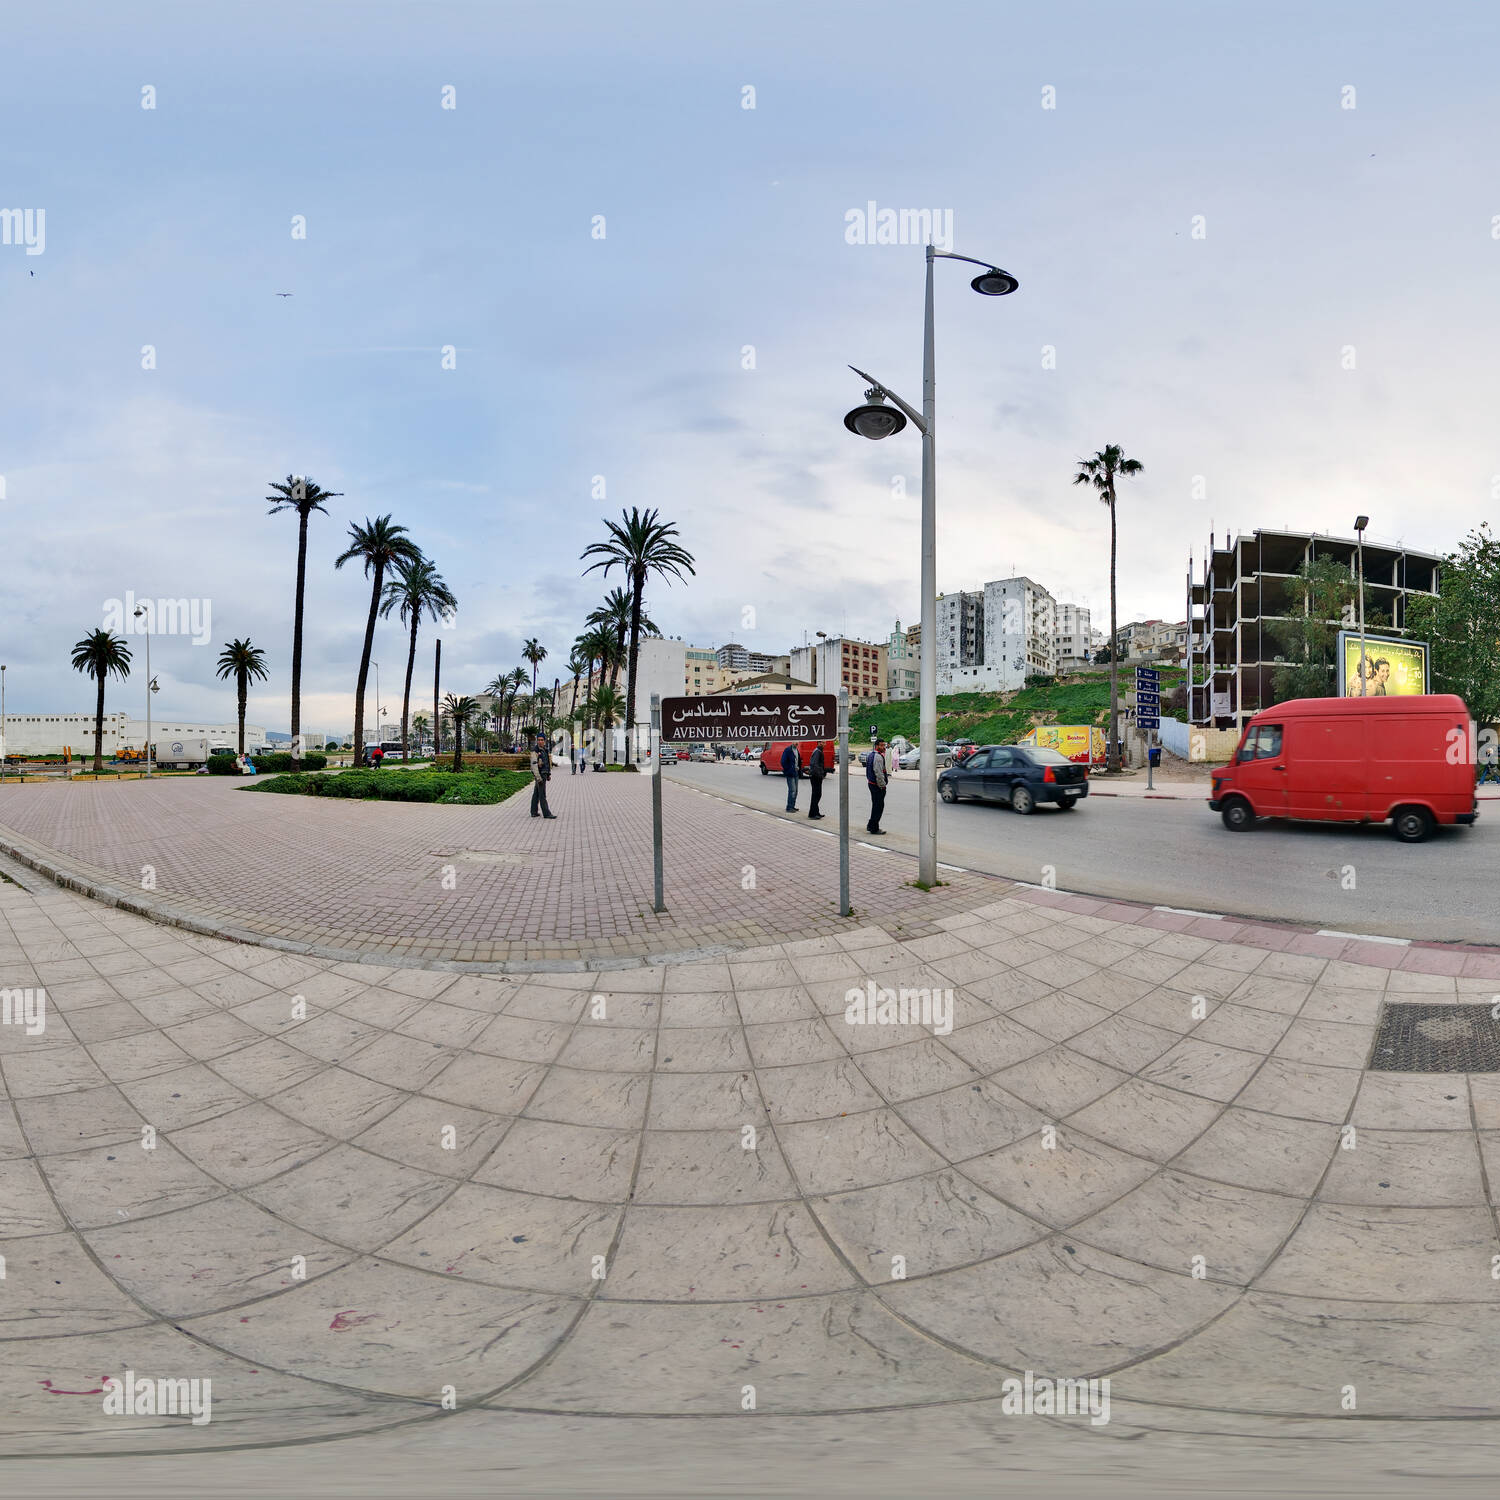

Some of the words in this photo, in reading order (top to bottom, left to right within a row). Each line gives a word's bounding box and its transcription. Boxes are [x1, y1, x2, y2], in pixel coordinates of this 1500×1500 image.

[672, 700, 731, 722] السادس
[740, 702, 781, 716] محمد
[787, 704, 825, 723] محج
[673, 726, 723, 738] AVENUE
[727, 725, 808, 738] MOHAMMED
[812, 725, 825, 737] VI
